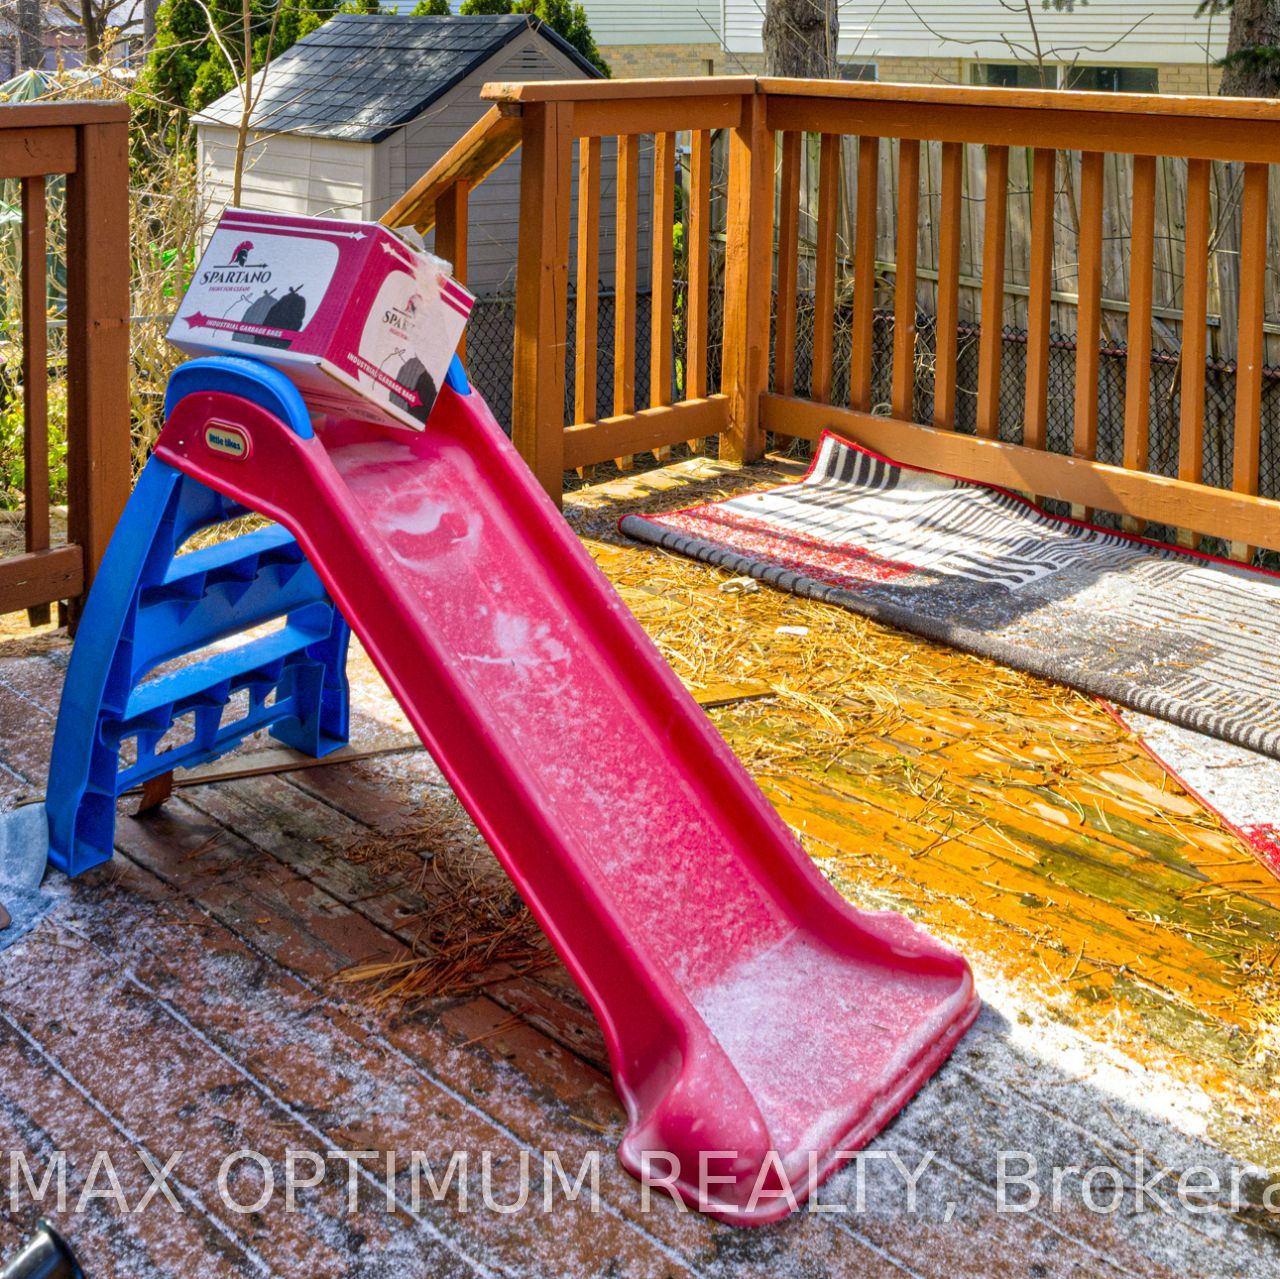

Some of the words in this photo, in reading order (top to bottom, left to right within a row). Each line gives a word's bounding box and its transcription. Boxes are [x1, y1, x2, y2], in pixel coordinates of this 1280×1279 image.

[200, 271, 272, 285] SPARTANO
[206, 319, 239, 330] INDUSTRIAL
[239, 324, 267, 335] GARBAGE
[266, 329, 283, 337] BAGS
[347, 352, 378, 378] INDUSTRIAL
[378, 371, 402, 395] GARBAGE
[401, 388, 416, 403] BAGS
